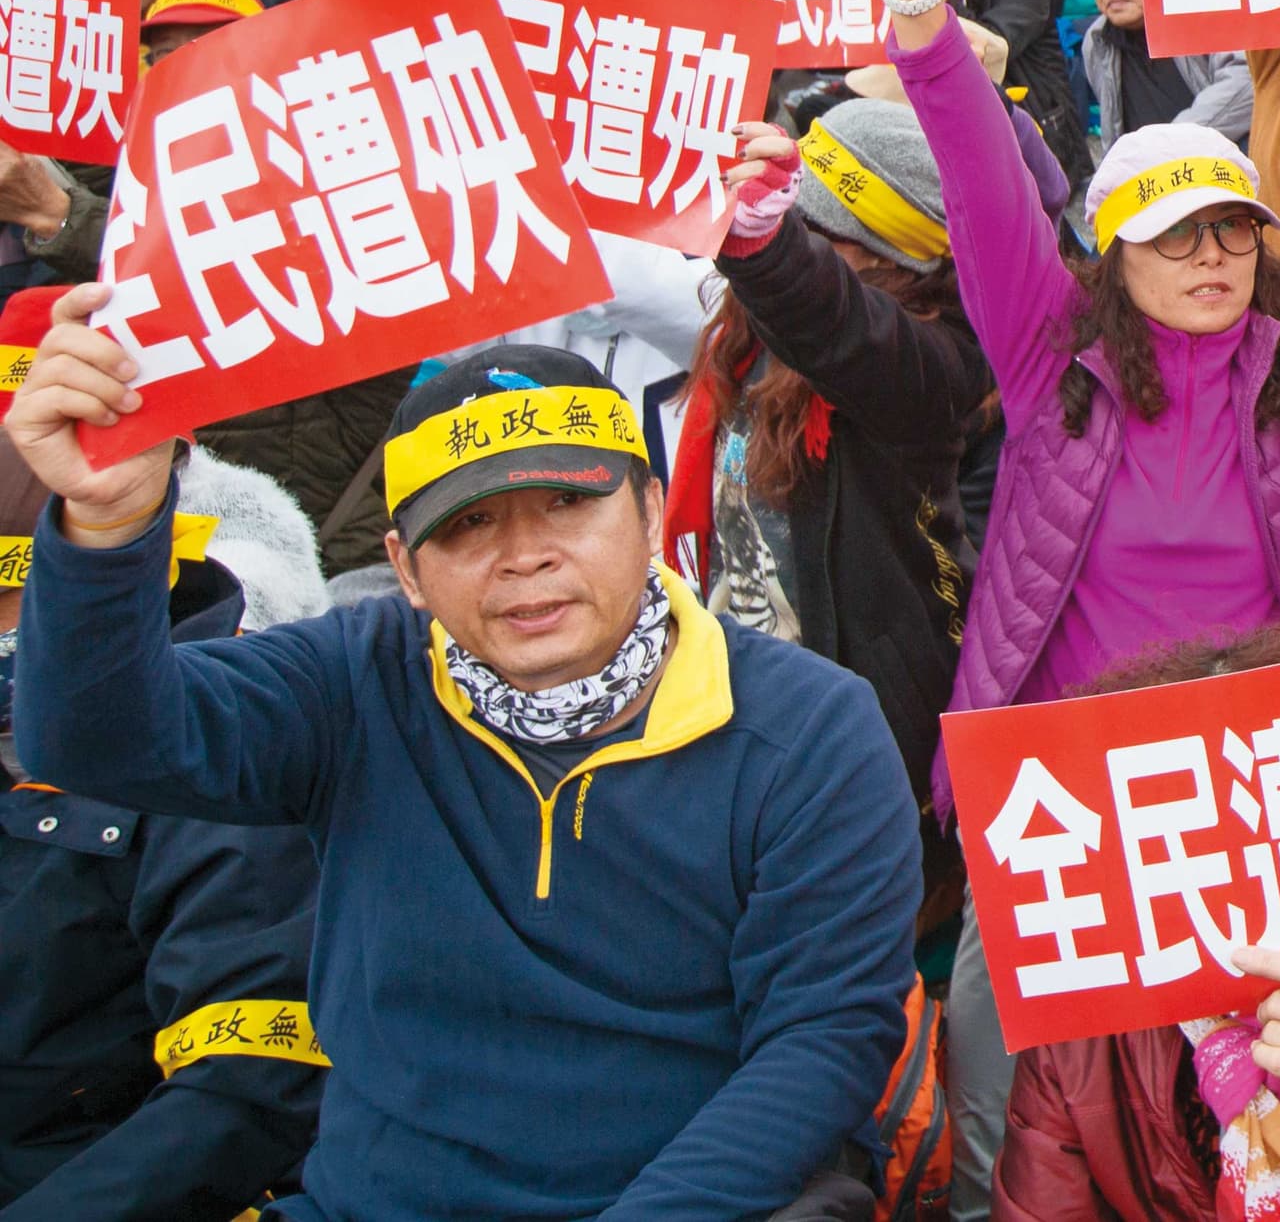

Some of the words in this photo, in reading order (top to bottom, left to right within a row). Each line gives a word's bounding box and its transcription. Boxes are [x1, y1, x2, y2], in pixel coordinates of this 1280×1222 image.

[445, 394, 635, 460] 執政無能
[166, 1006, 326, 1062] 執政無
